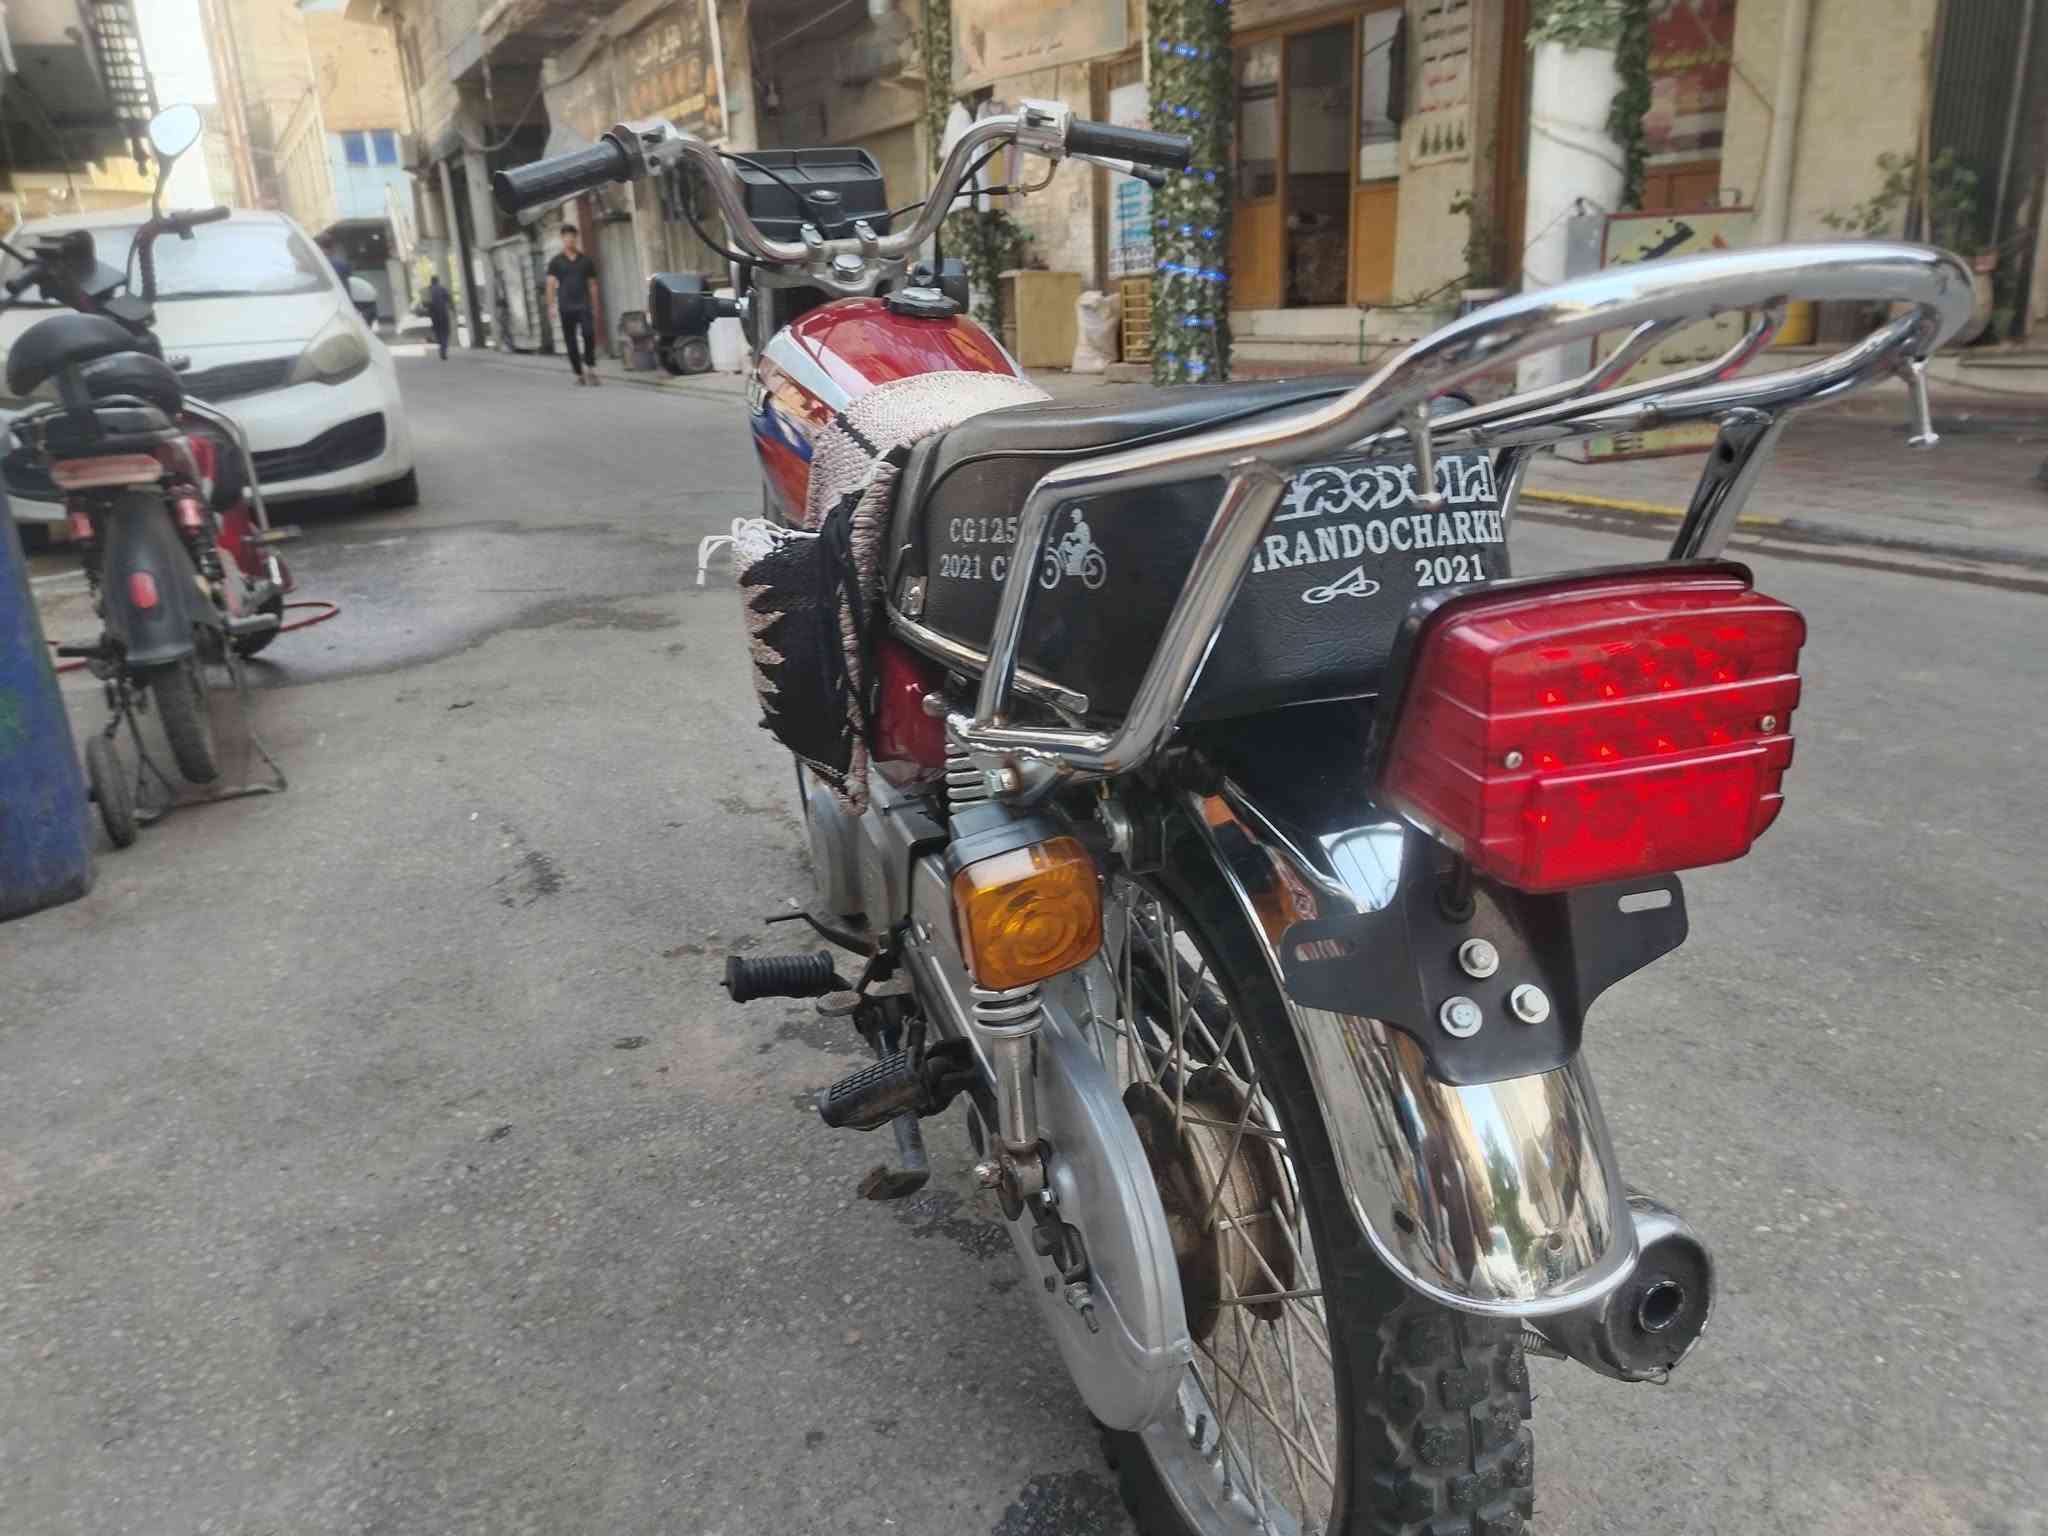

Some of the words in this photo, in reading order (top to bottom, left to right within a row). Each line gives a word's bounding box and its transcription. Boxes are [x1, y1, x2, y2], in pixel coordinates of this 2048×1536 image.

[950, 516, 1017, 543] CG125
[940, 553, 982, 579] 2021
[990, 555, 1012, 582] C
[1415, 554, 1486, 587] 2021
